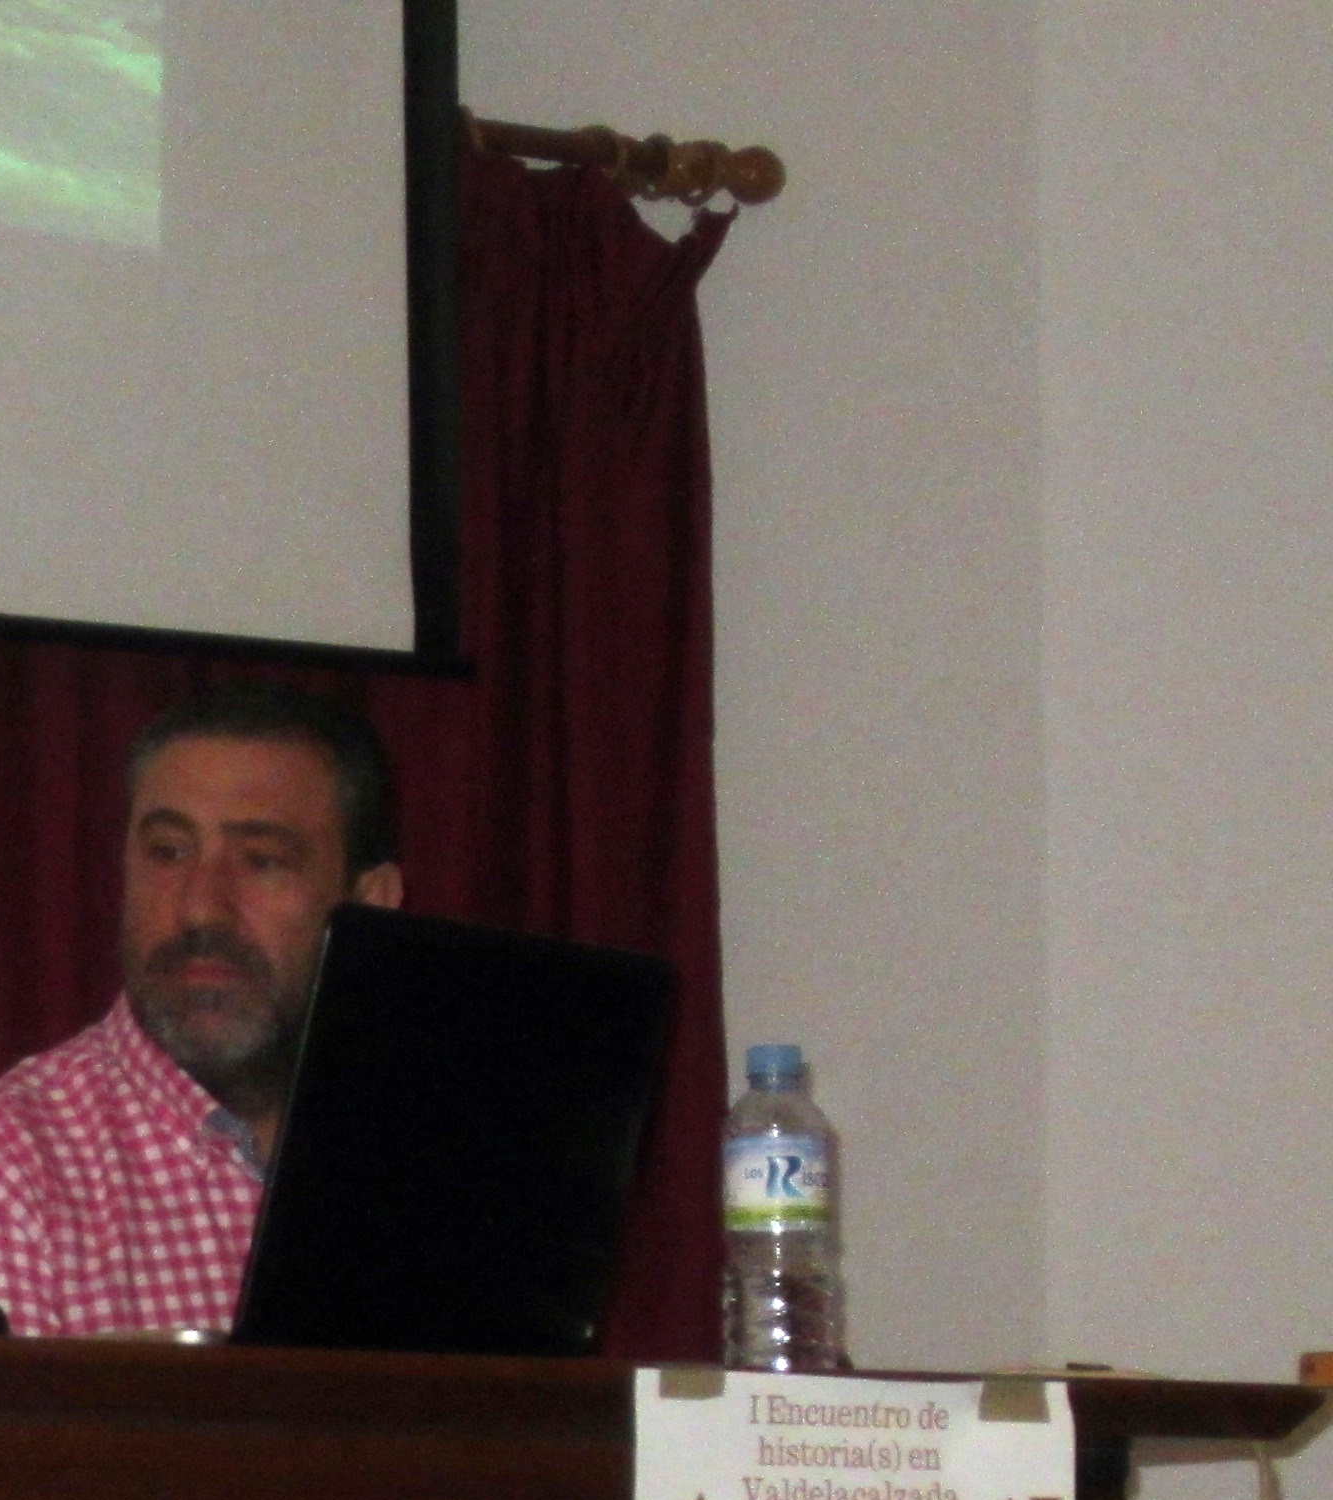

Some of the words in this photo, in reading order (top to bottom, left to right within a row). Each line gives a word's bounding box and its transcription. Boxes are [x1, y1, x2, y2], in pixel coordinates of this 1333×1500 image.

[749, 1394, 762, 1426] I
[766, 1394, 911, 1430] Encuentro
[918, 1401, 951, 1430] de
[759, 1435, 901, 1473] historia(s)
[908, 1446, 942, 1472] en
